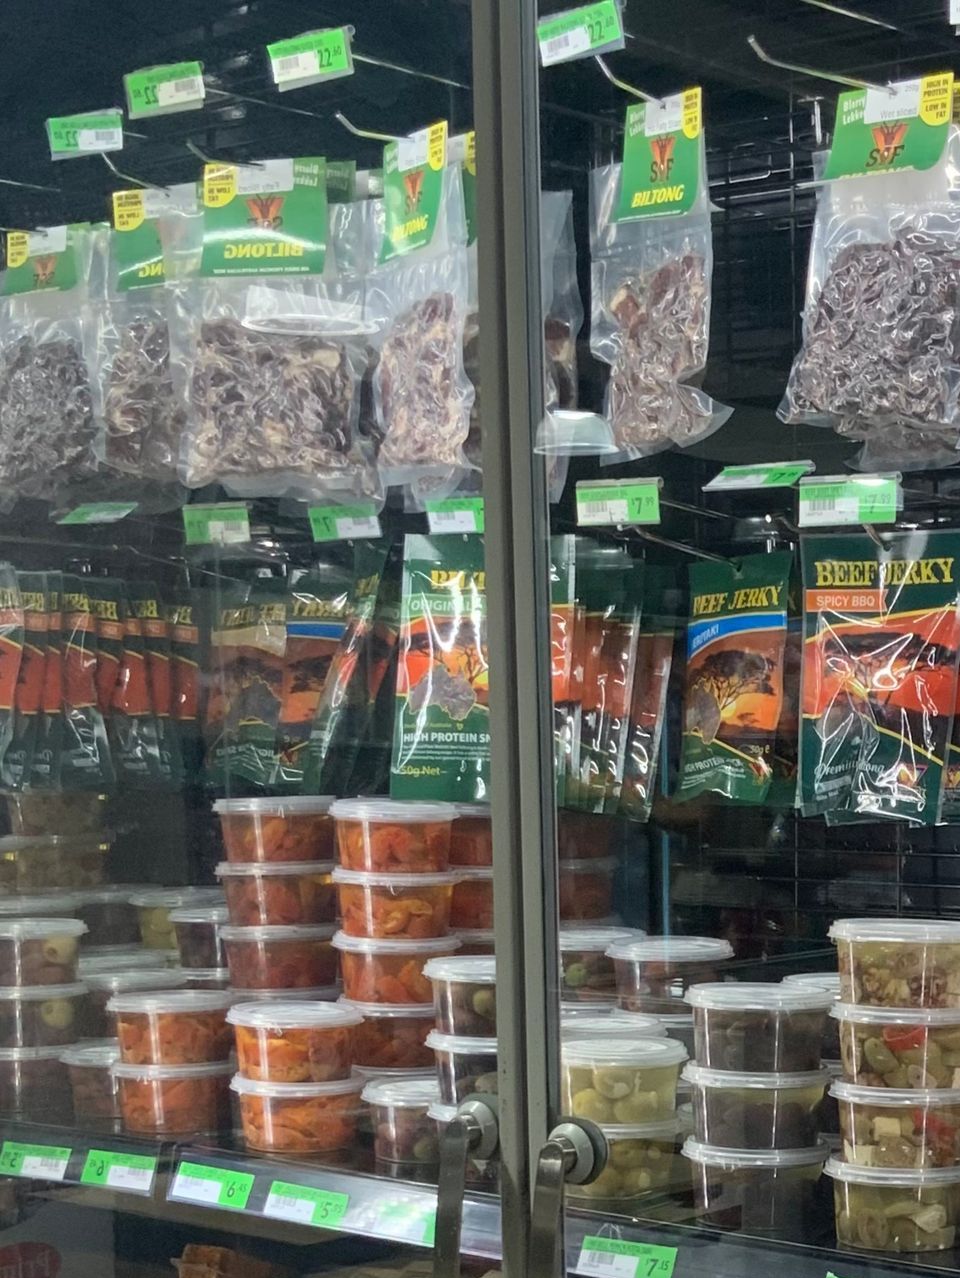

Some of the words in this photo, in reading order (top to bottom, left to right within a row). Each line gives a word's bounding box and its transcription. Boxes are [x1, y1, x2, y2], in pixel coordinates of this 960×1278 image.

[923, 87, 948, 98] PROTEIN
[925, 103, 938, 113] LOW
[935, 110, 947, 119] FAT
[631, 184, 684, 208] BILTONG
[815, 560, 880, 587] BEEF
[883, 558, 954, 586] JERKY
[693, 594, 728, 616] BEEF
[728, 586, 782, 610] JERKY
[816, 595, 848, 607] SPICY
[851, 595, 875, 607] BBQ
[431, 733, 477, 746] PROTEIN
